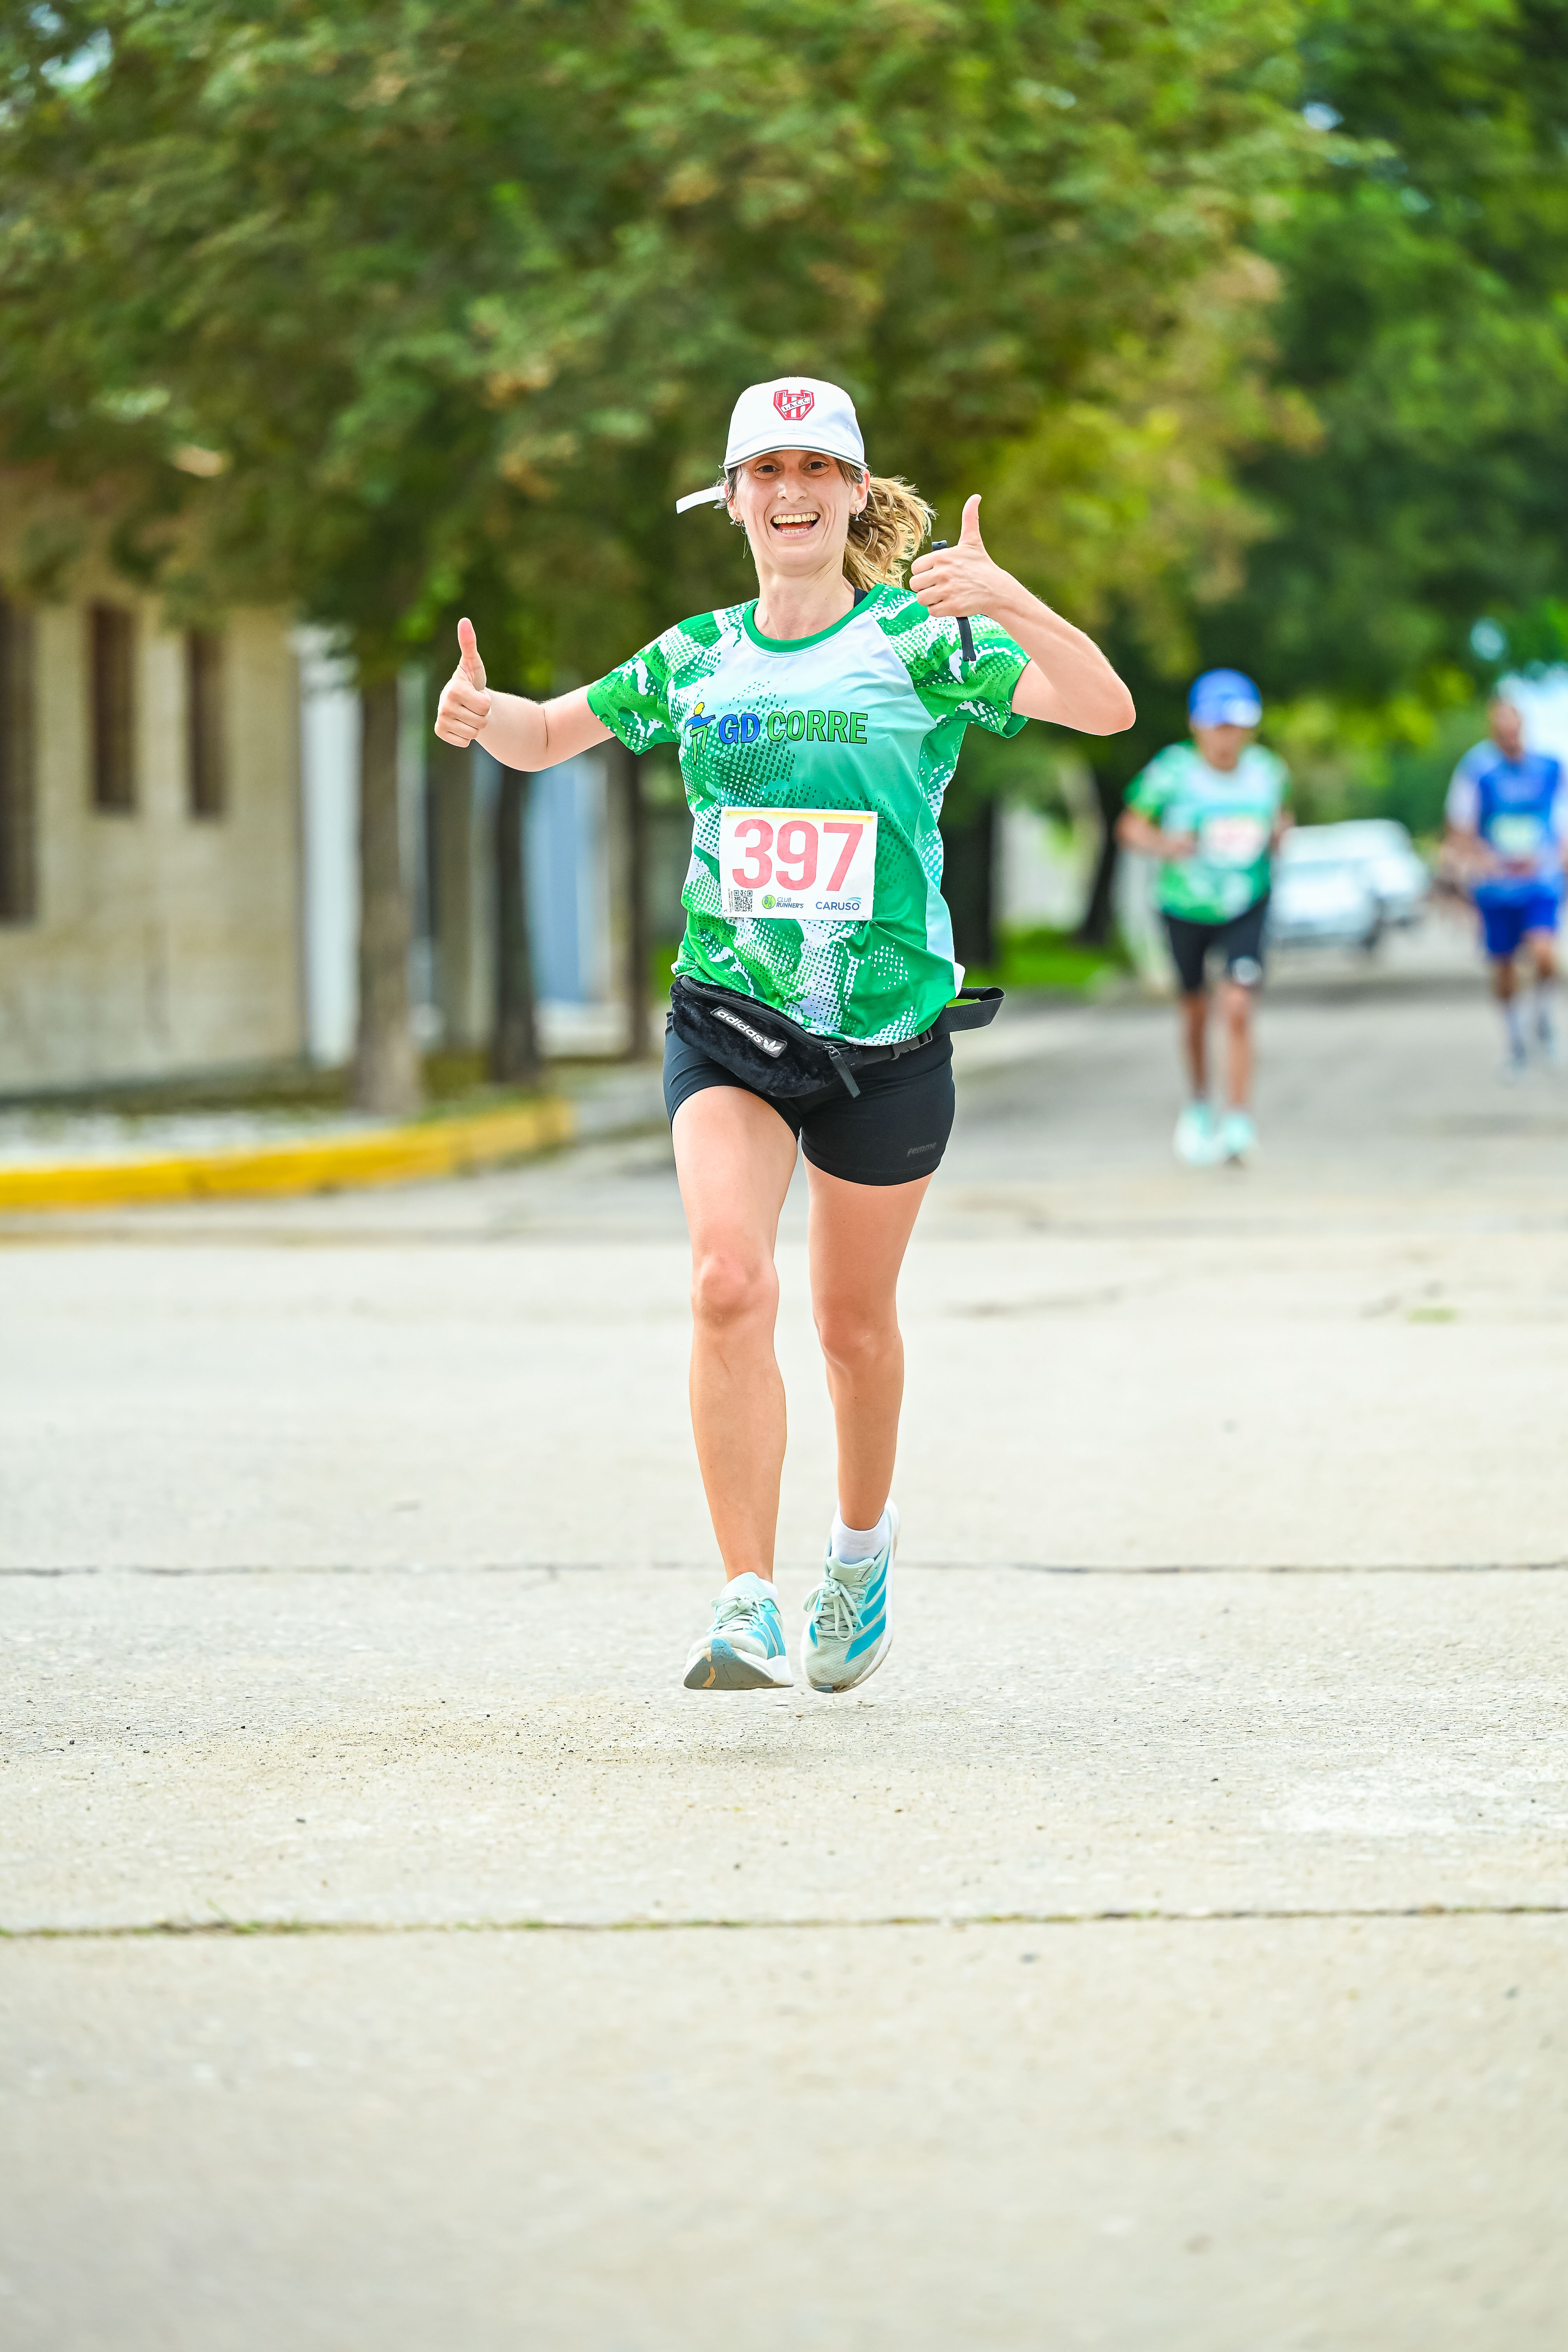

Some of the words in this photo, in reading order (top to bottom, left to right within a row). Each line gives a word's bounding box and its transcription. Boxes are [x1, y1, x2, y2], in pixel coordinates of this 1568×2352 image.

[718, 714, 760, 744] GD
[768, 710, 868, 744] CORRE
[732, 819, 863, 891] 397
[816, 901, 859, 910] CARUSO
[717, 1011, 763, 1043] adidas
